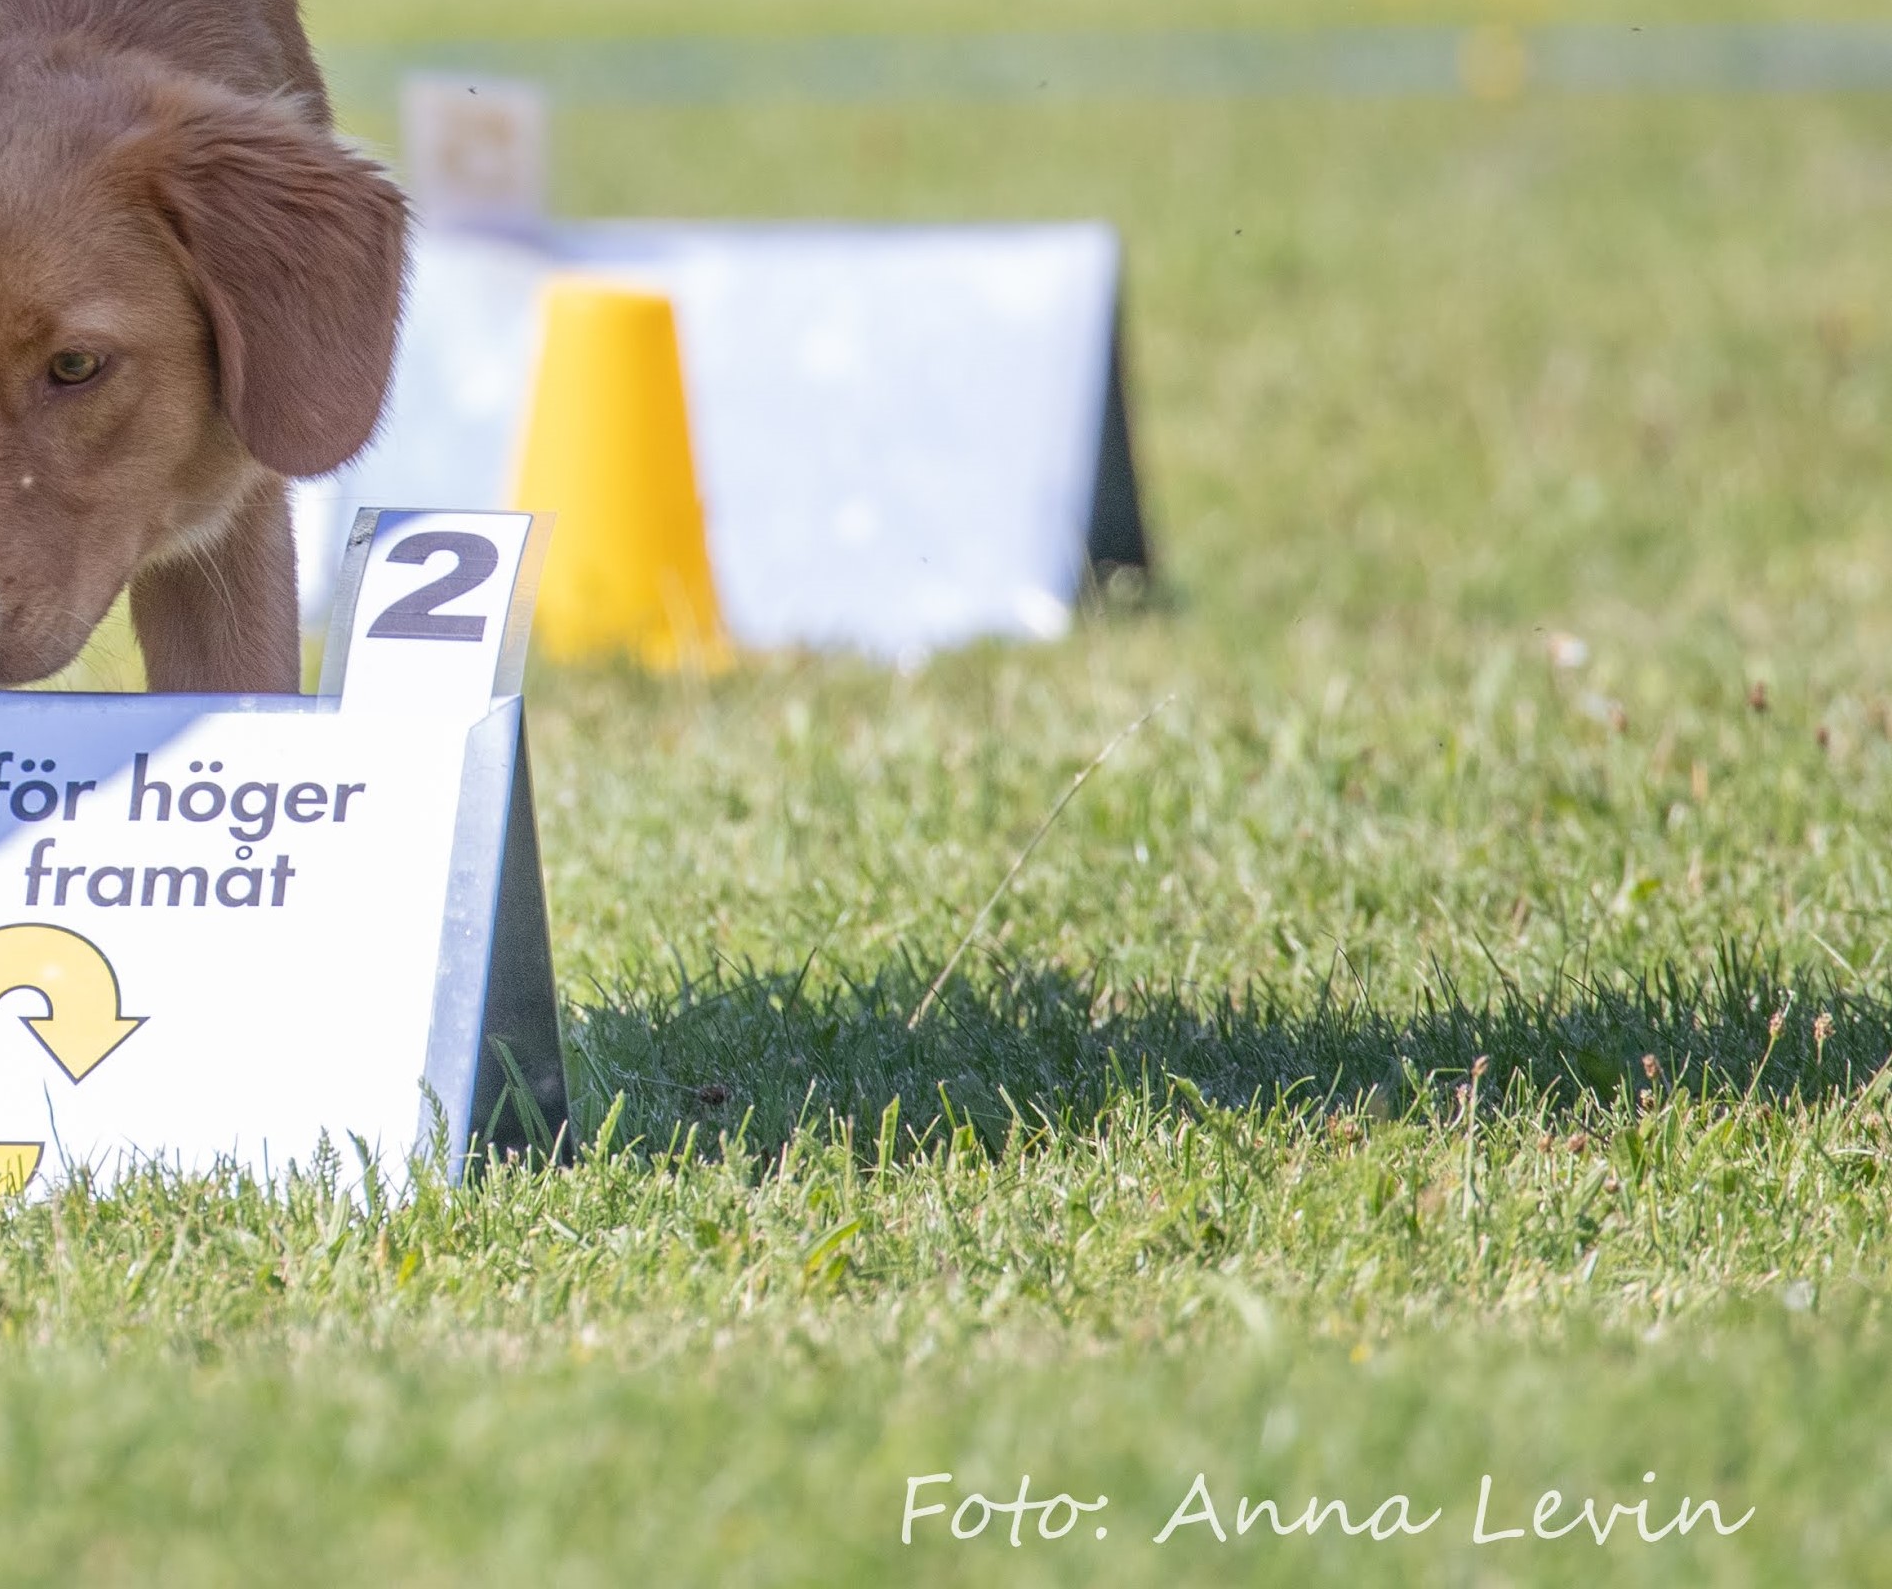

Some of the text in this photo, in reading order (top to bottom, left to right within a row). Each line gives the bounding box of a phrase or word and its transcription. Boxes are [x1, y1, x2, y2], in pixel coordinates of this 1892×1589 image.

[366, 530, 500, 642] 2
[128, 752, 367, 844] höger
[24, 837, 296, 908] framåt
